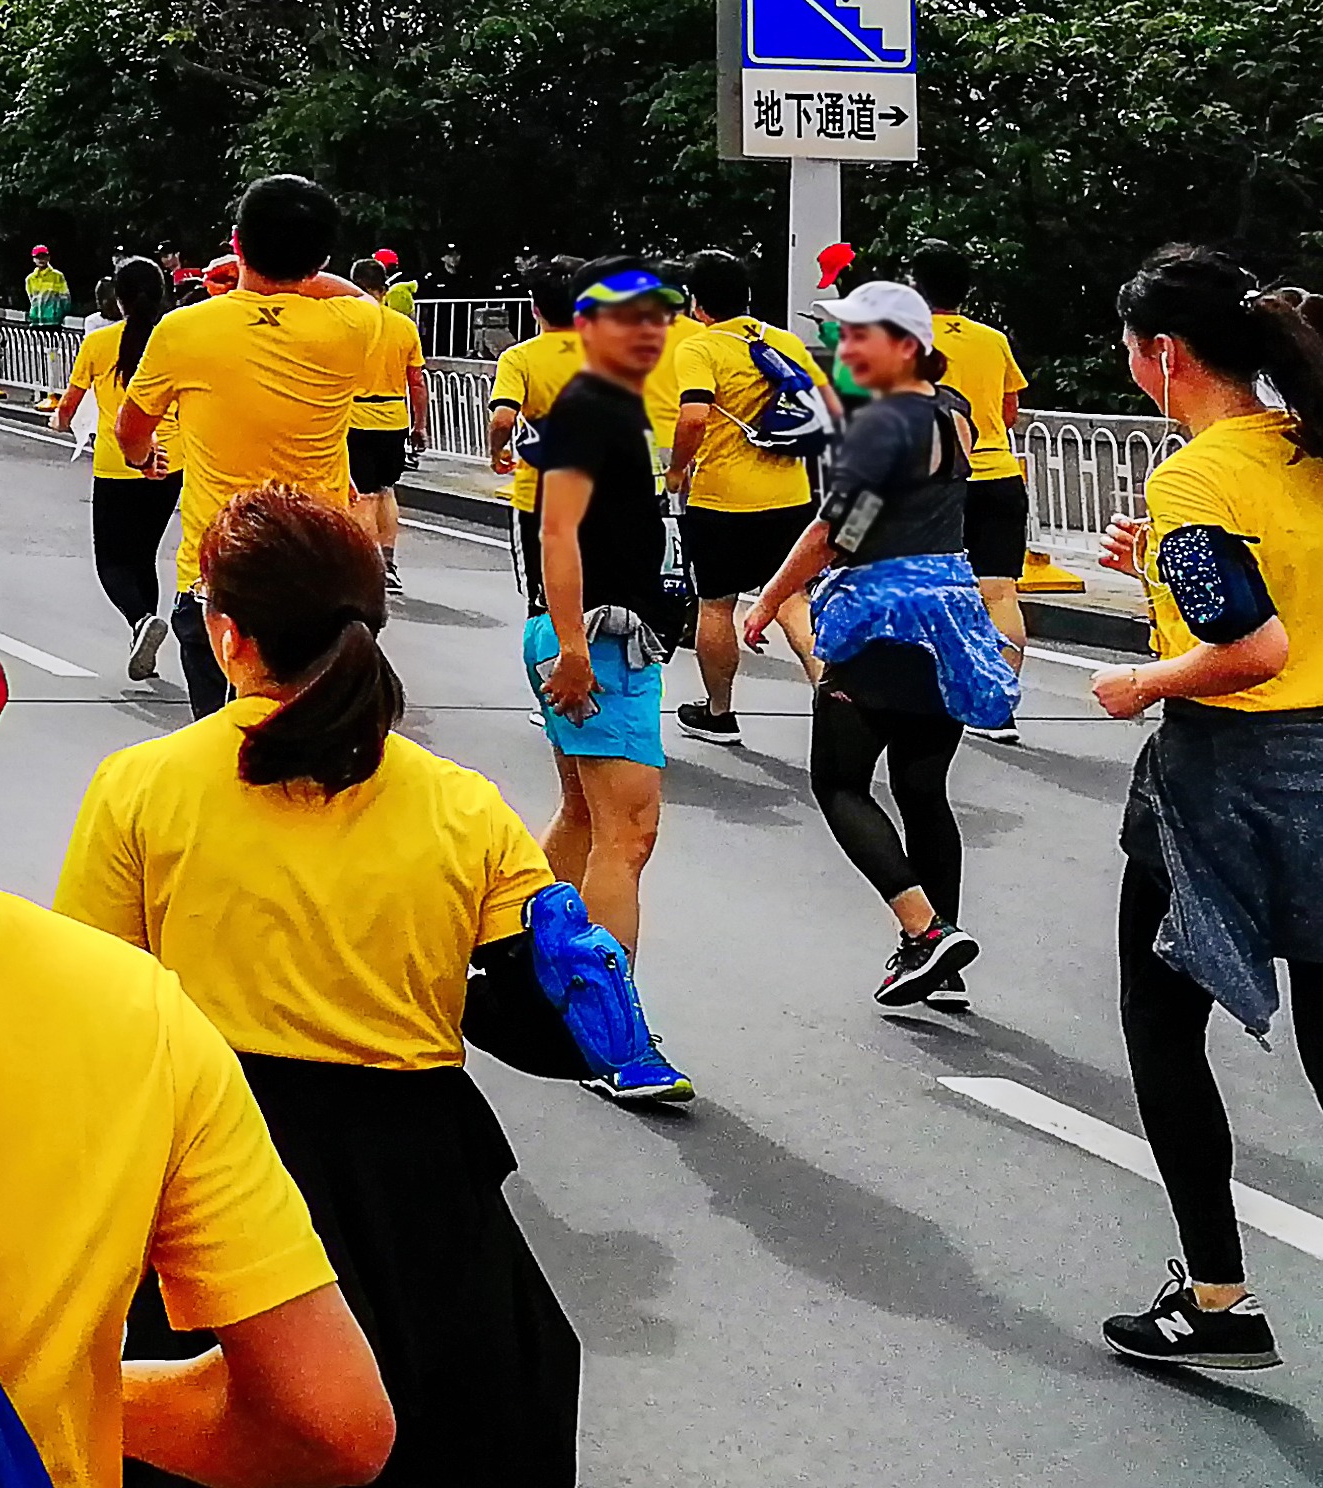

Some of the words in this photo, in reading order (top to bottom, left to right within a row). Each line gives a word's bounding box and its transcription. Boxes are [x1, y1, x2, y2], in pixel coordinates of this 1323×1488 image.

[753, 89, 877, 141] 地下通道
[1154, 1310, 1195, 1344] N
